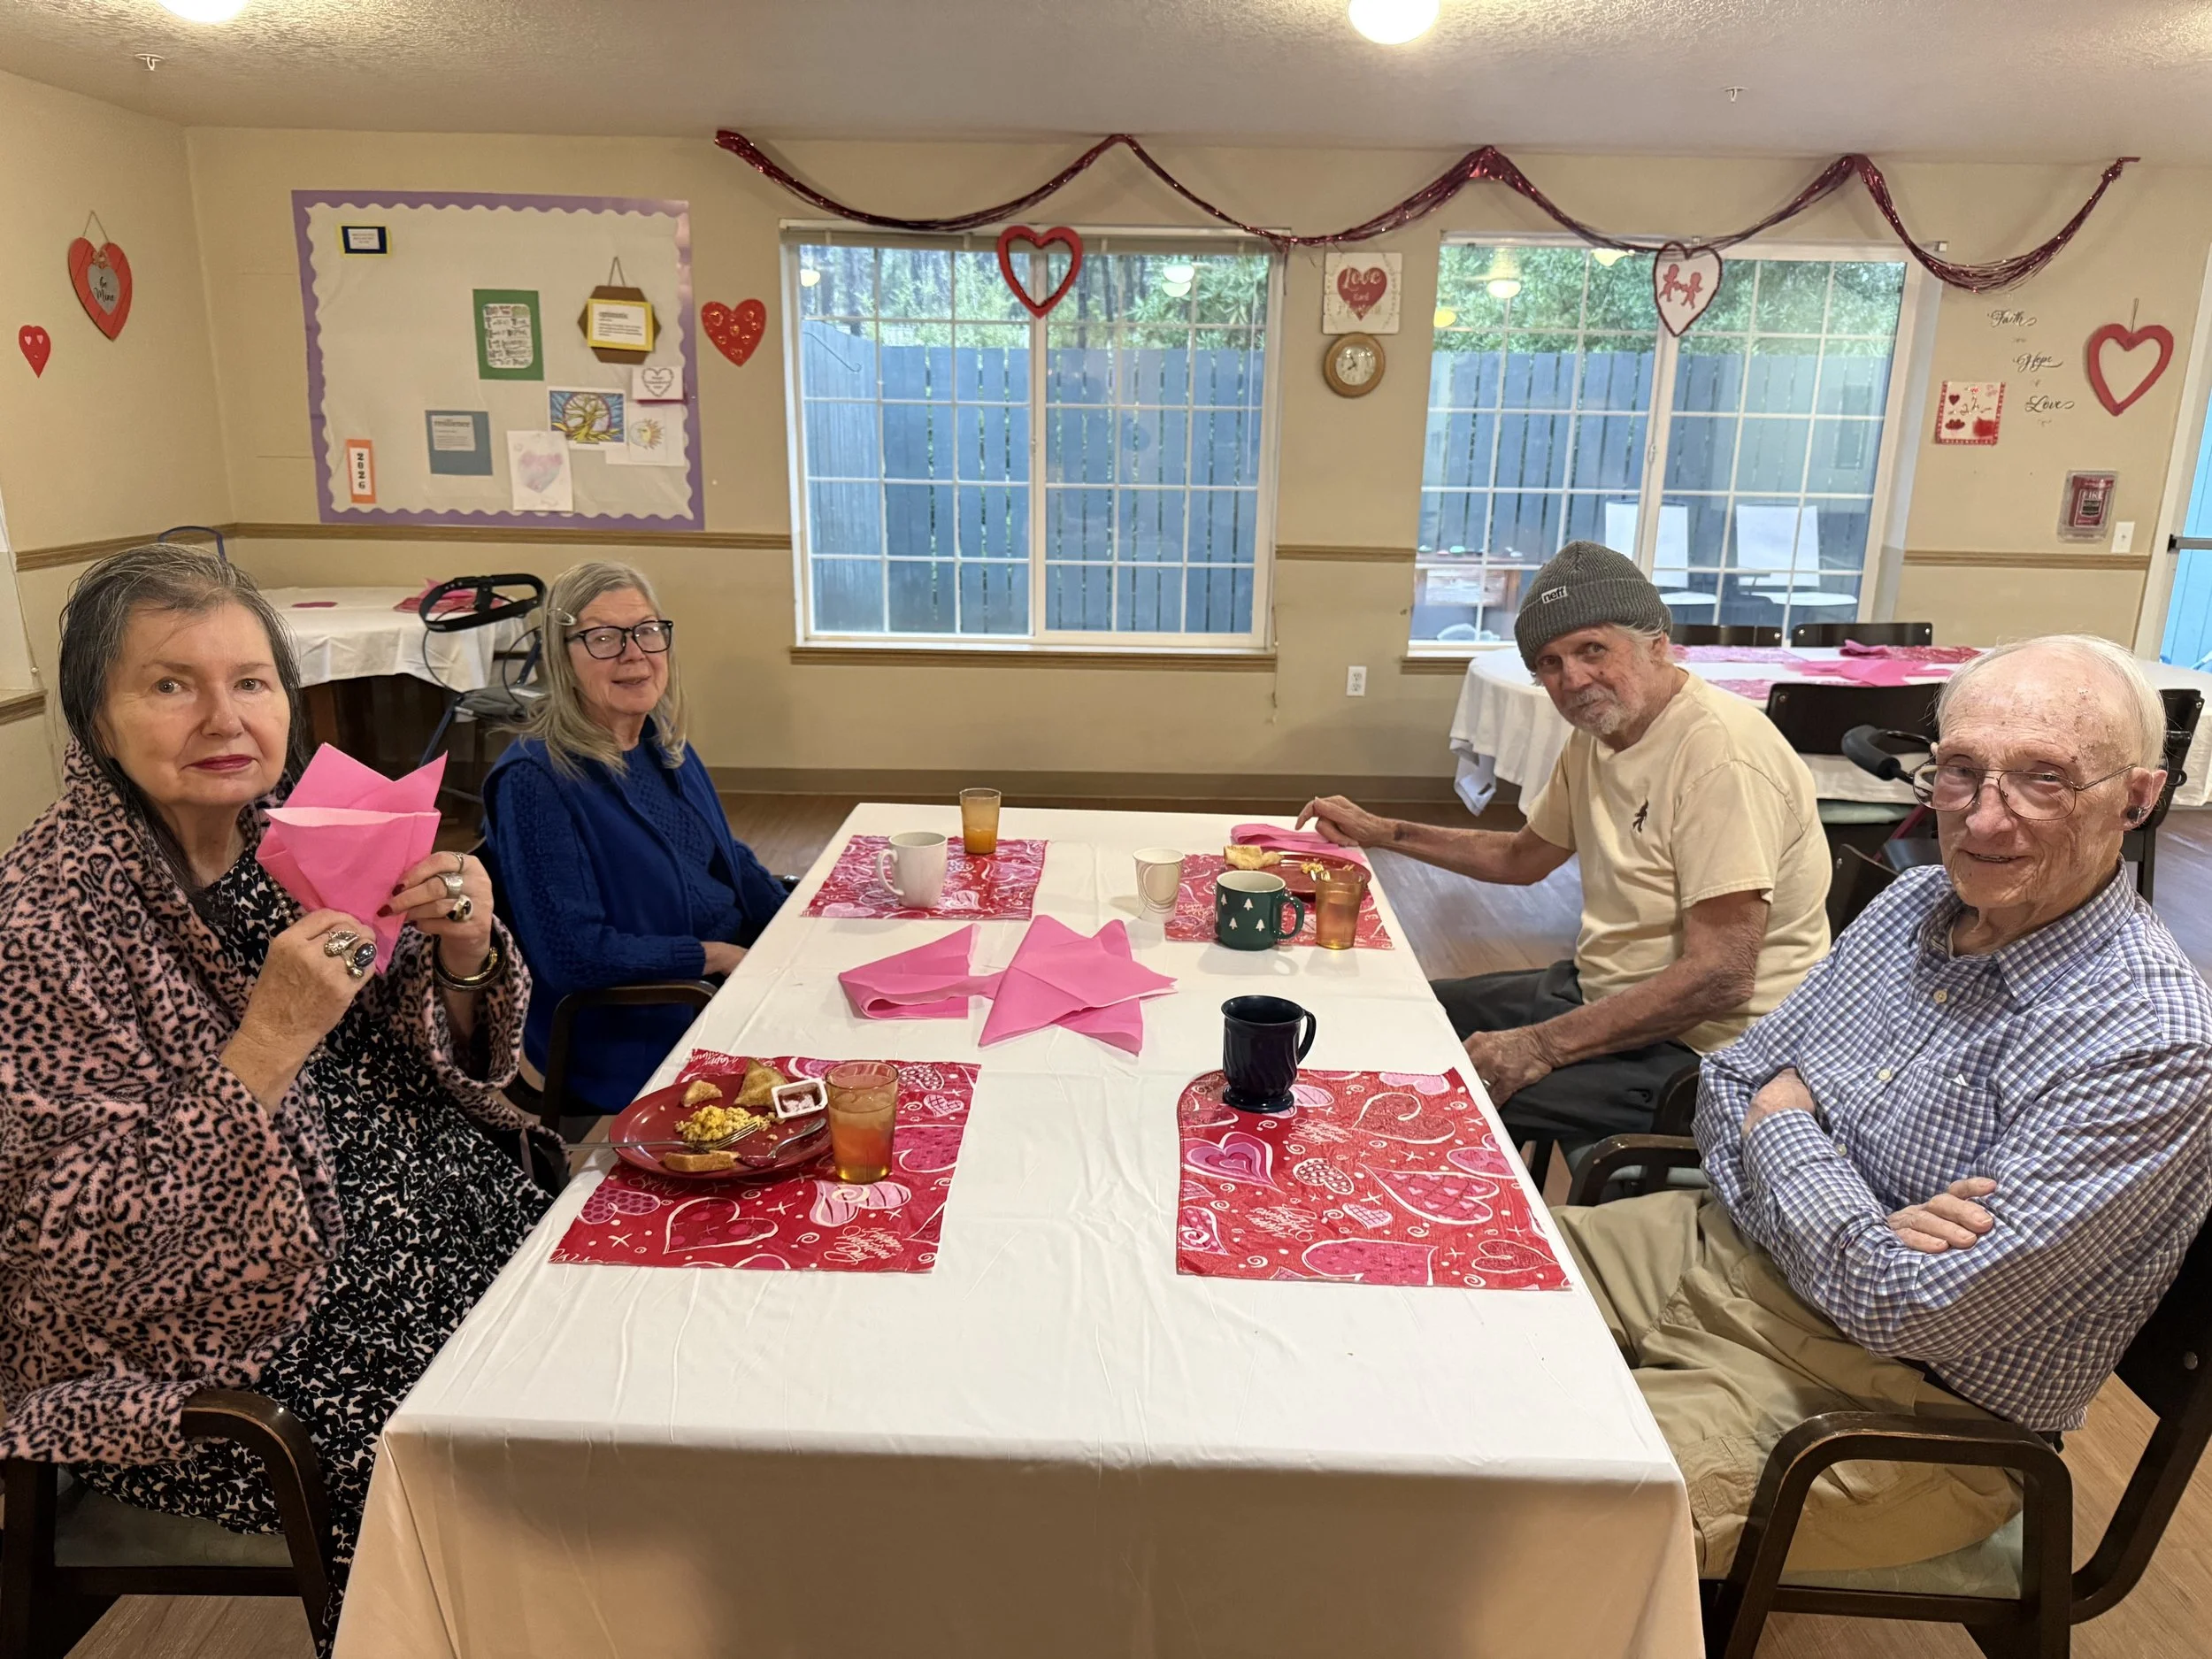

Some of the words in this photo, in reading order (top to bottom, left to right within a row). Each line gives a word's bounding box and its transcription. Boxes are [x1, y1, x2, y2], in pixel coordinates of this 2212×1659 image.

[1341, 267, 1382, 291] Love
[1986, 309, 2037, 327] Faith
[2013, 352, 2063, 373] Hope
[2024, 395, 2075, 412] Love
[357, 453, 365, 489] 2026
[1543, 588, 1564, 602] neff
